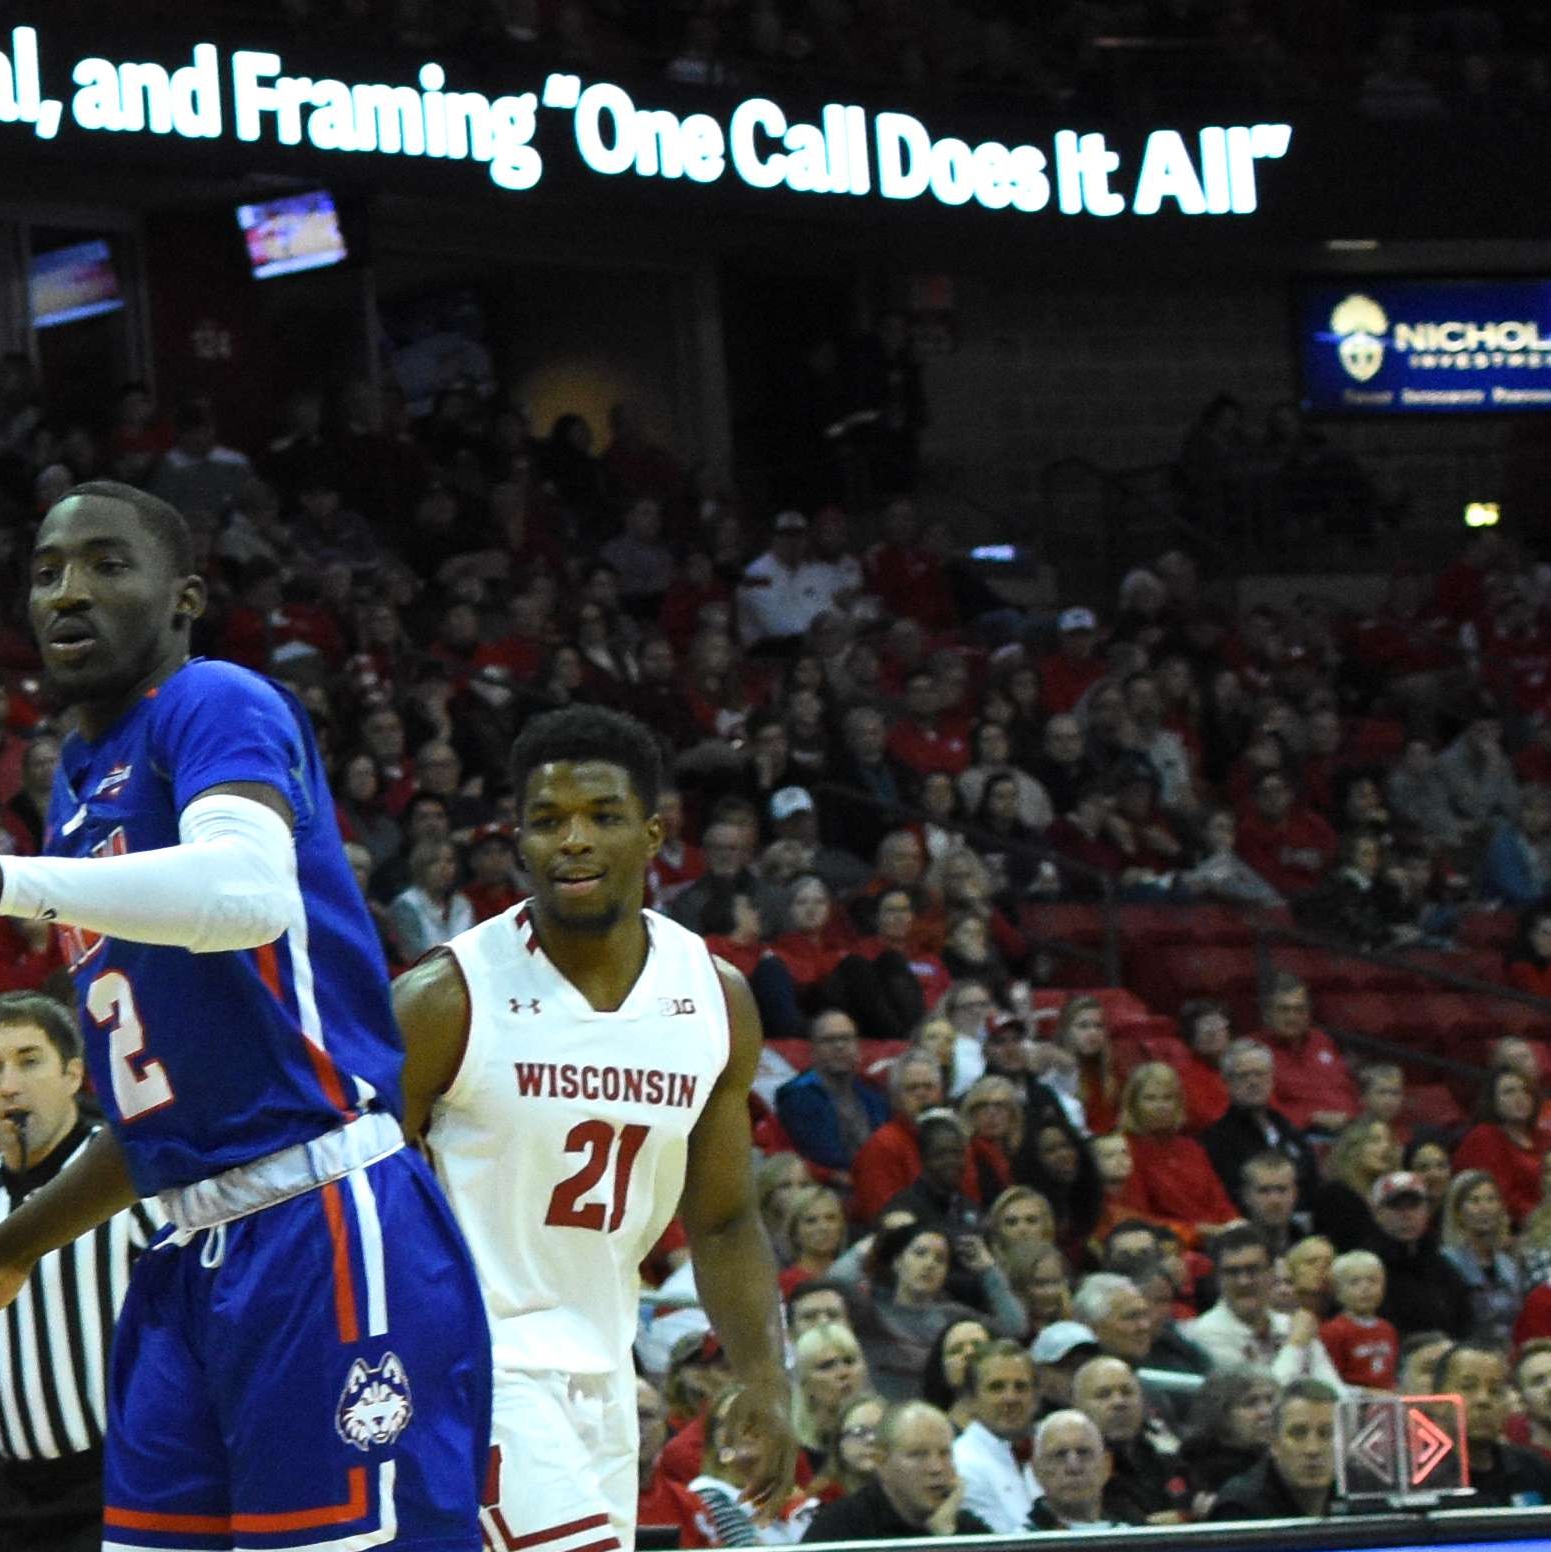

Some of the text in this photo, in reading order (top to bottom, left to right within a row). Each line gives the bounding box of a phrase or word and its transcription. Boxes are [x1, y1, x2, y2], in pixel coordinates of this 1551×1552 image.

[72, 43, 222, 138] and
[232, 51, 542, 190] Framing
[730, 98, 871, 195] Call
[875, 112, 1050, 212] Does
[1054, 130, 1125, 216] It
[87, 967, 175, 1122] 2
[514, 1062, 697, 1108] WISCONSIN
[545, 1119, 651, 1234] 21
